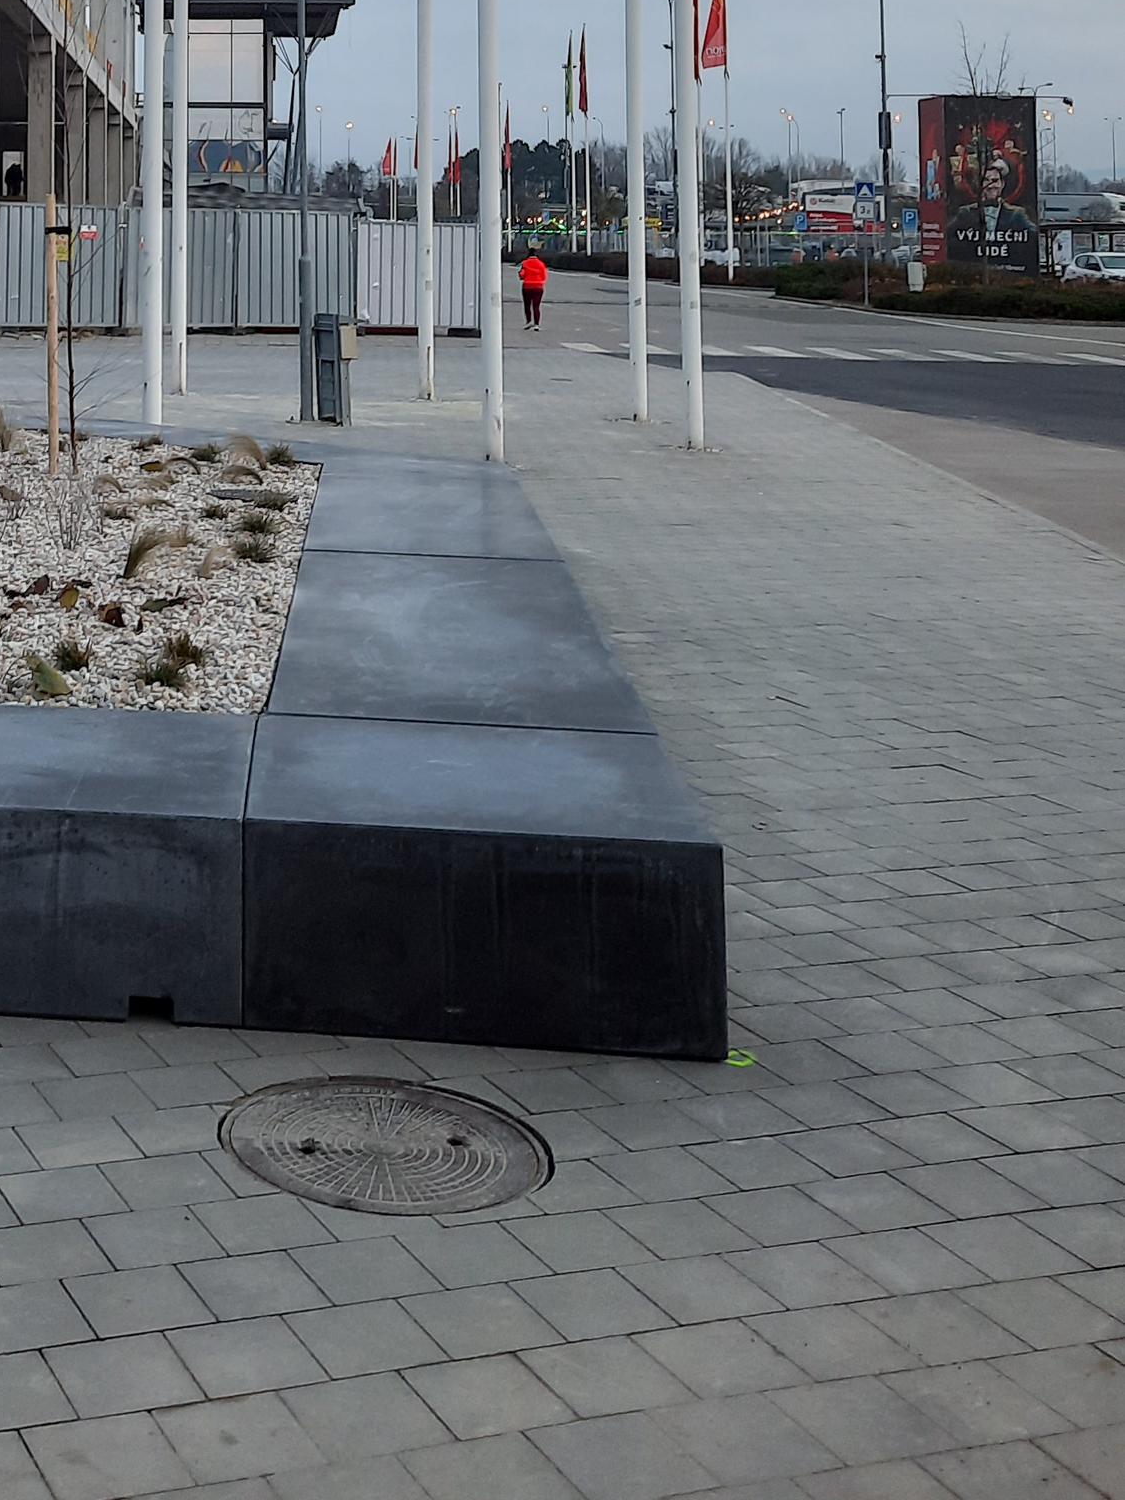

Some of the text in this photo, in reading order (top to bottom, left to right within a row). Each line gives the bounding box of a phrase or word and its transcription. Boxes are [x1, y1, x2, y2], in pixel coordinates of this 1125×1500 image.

[905, 212, 914, 222] P
[956, 228, 1028, 242] VÝJMEČNÍ
[977, 244, 1009, 257] LIDÉ
